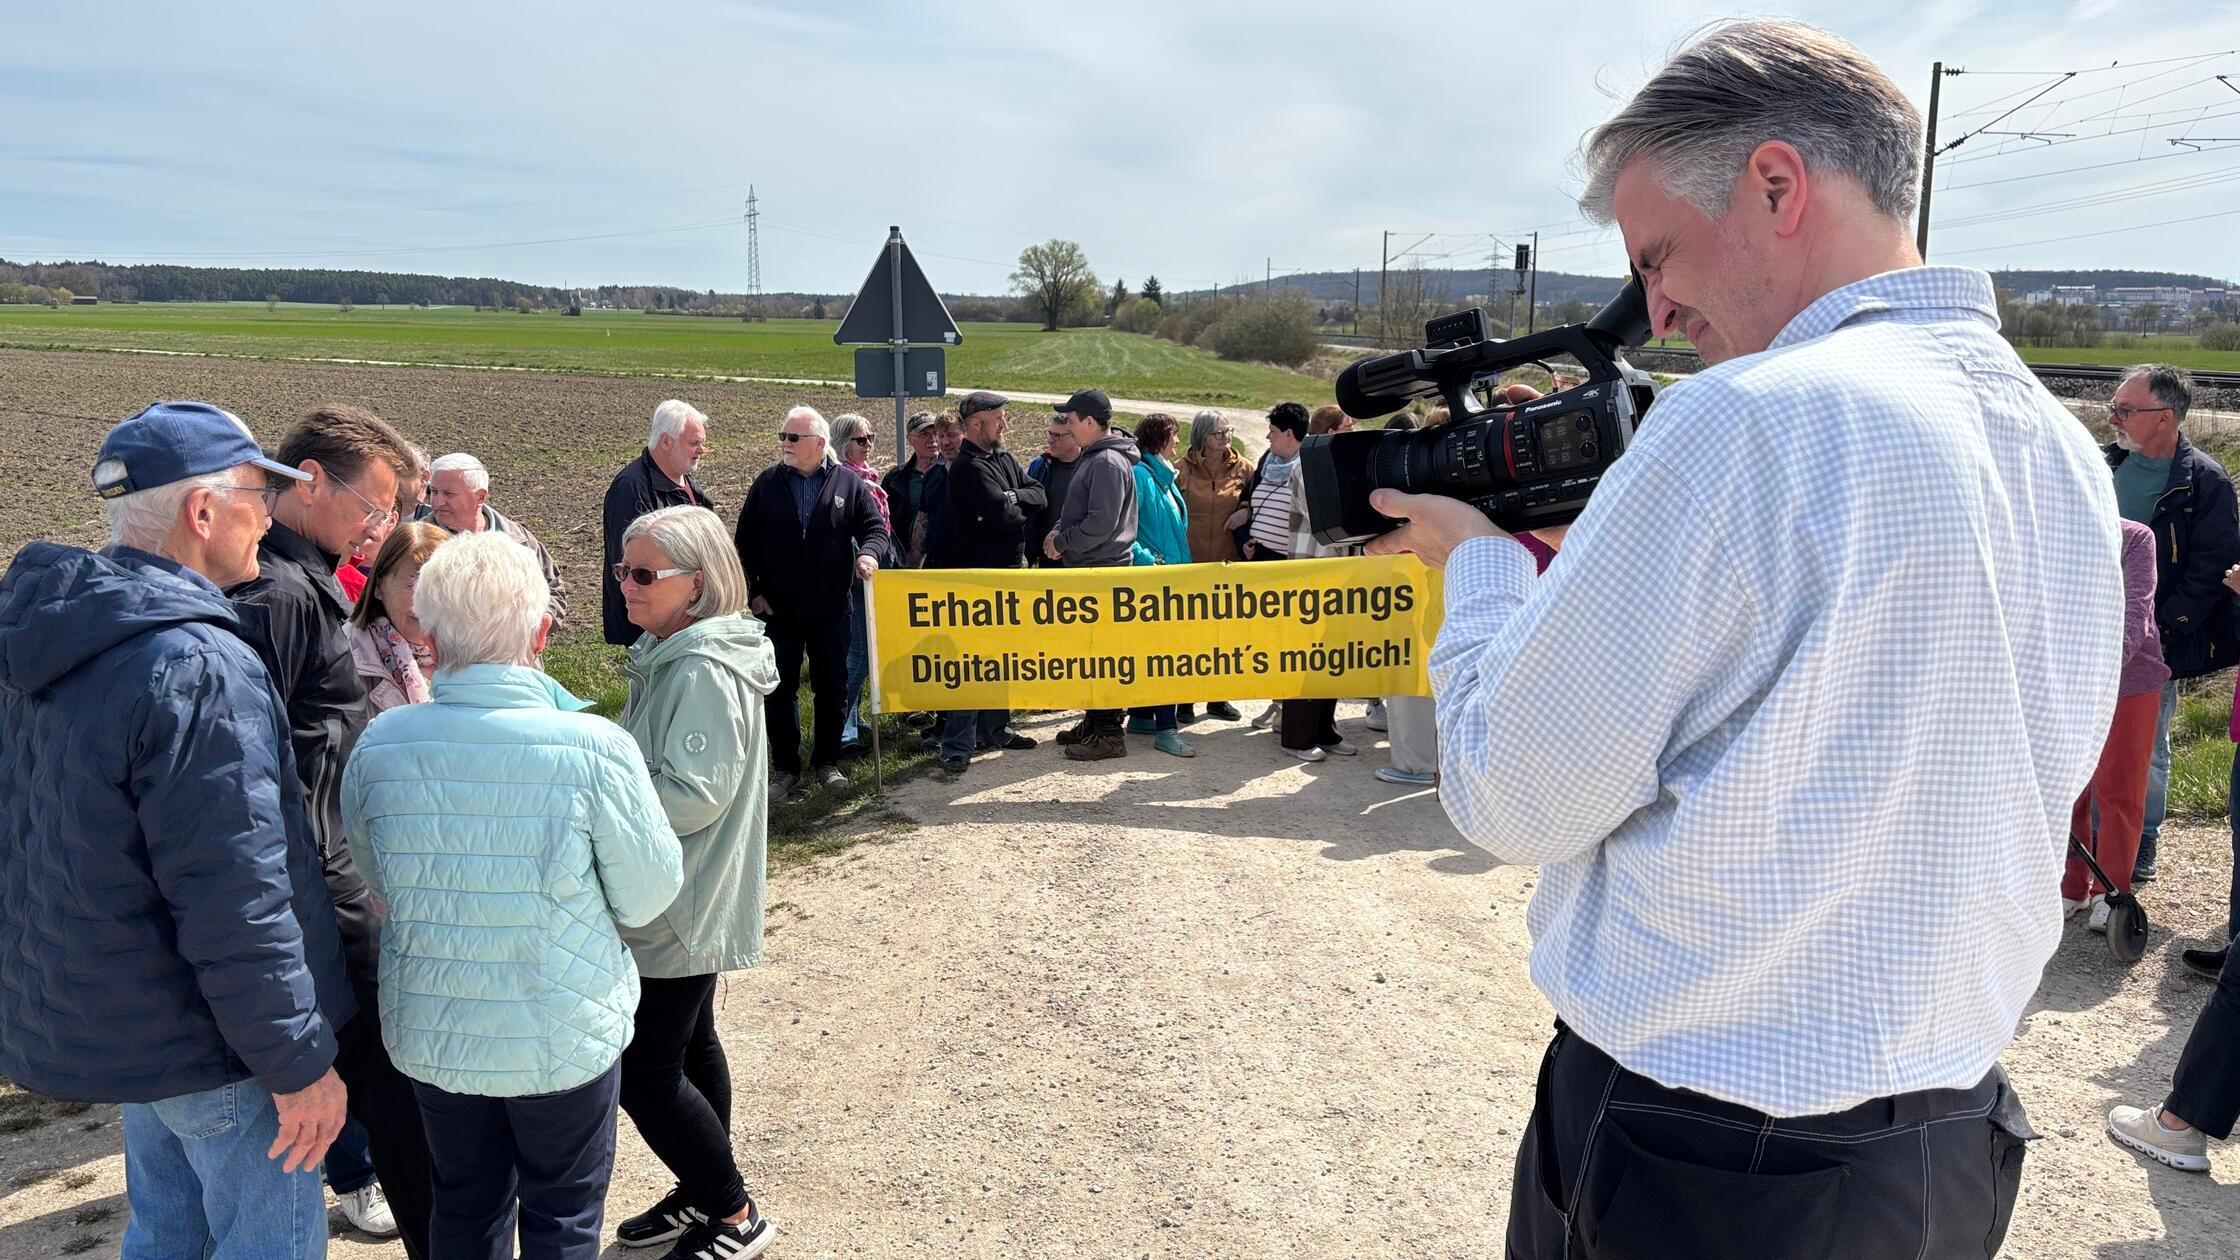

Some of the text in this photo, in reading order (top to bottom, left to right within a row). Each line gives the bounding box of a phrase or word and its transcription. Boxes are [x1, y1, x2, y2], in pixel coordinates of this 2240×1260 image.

[1524, 399, 1562, 413] Panasonic
[907, 583, 1415, 628] Erhalt des Bahnübergangs
[911, 652, 1136, 690] Digitalisierung
[1280, 637, 1412, 677] möglich!
